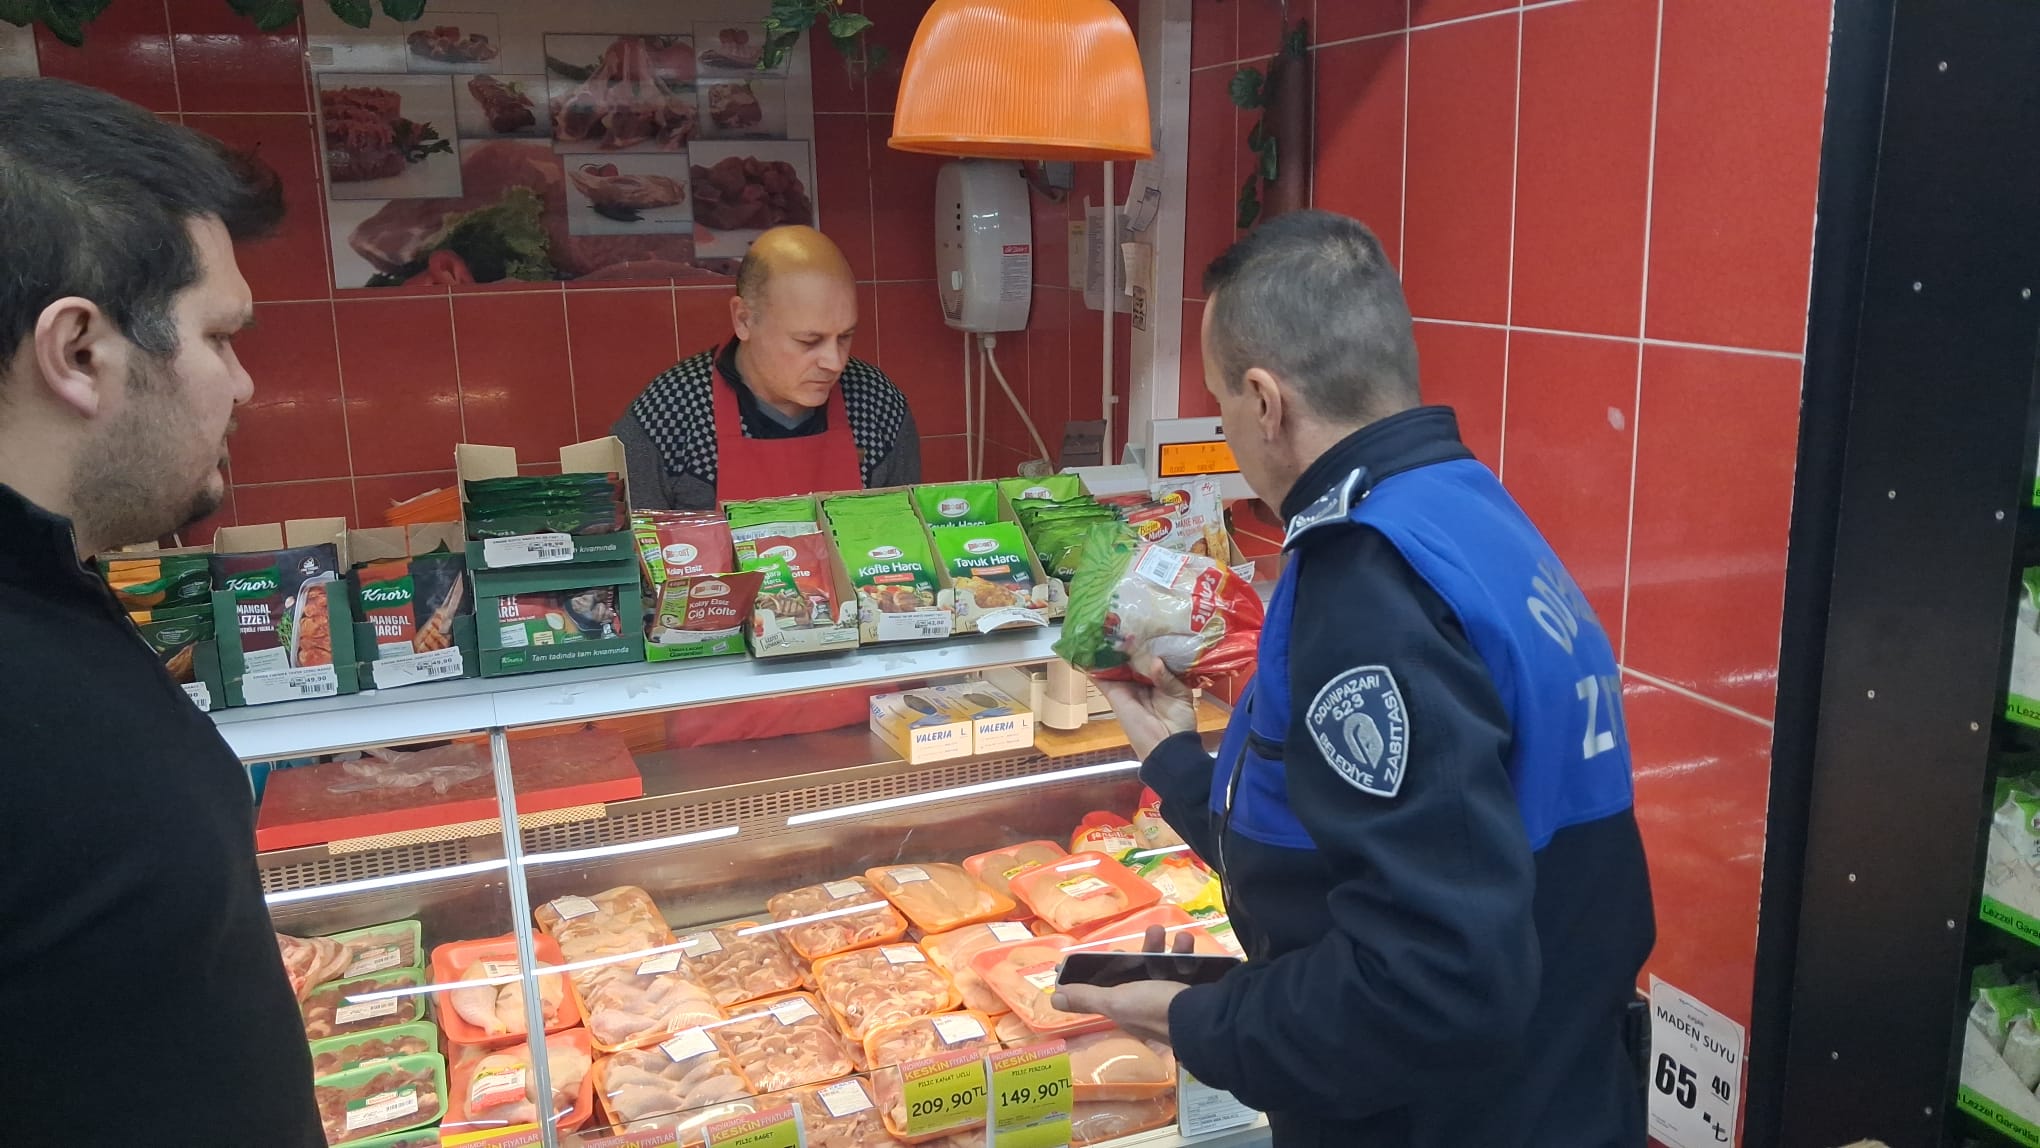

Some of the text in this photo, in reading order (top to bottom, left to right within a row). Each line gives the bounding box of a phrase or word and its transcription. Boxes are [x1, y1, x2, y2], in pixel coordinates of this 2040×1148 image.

[891, 561, 922, 572] Harcı
[954, 552, 1020, 570] Tavuk Harcı
[226, 576, 278, 592] Knorr
[361, 587, 412, 601] Knorr
[236, 603, 272, 615] MANGAL
[369, 615, 411, 625] MANGAL
[532, 653, 547, 663] Tam
[577, 648, 592, 659] tam
[1314, 674, 1380, 725] ODUNPAZARI
[979, 719, 1028, 734] VALERIA L
[916, 727, 967, 743] VALERIA L
[1381, 690, 1403, 784] ZABITASI
[1320, 732, 1375, 786] BELEDİYE
[1656, 1005, 1701, 1042] MADEN
[1702, 1035, 1736, 1064] SUYU
[1655, 1052, 1731, 1110] 65 40
